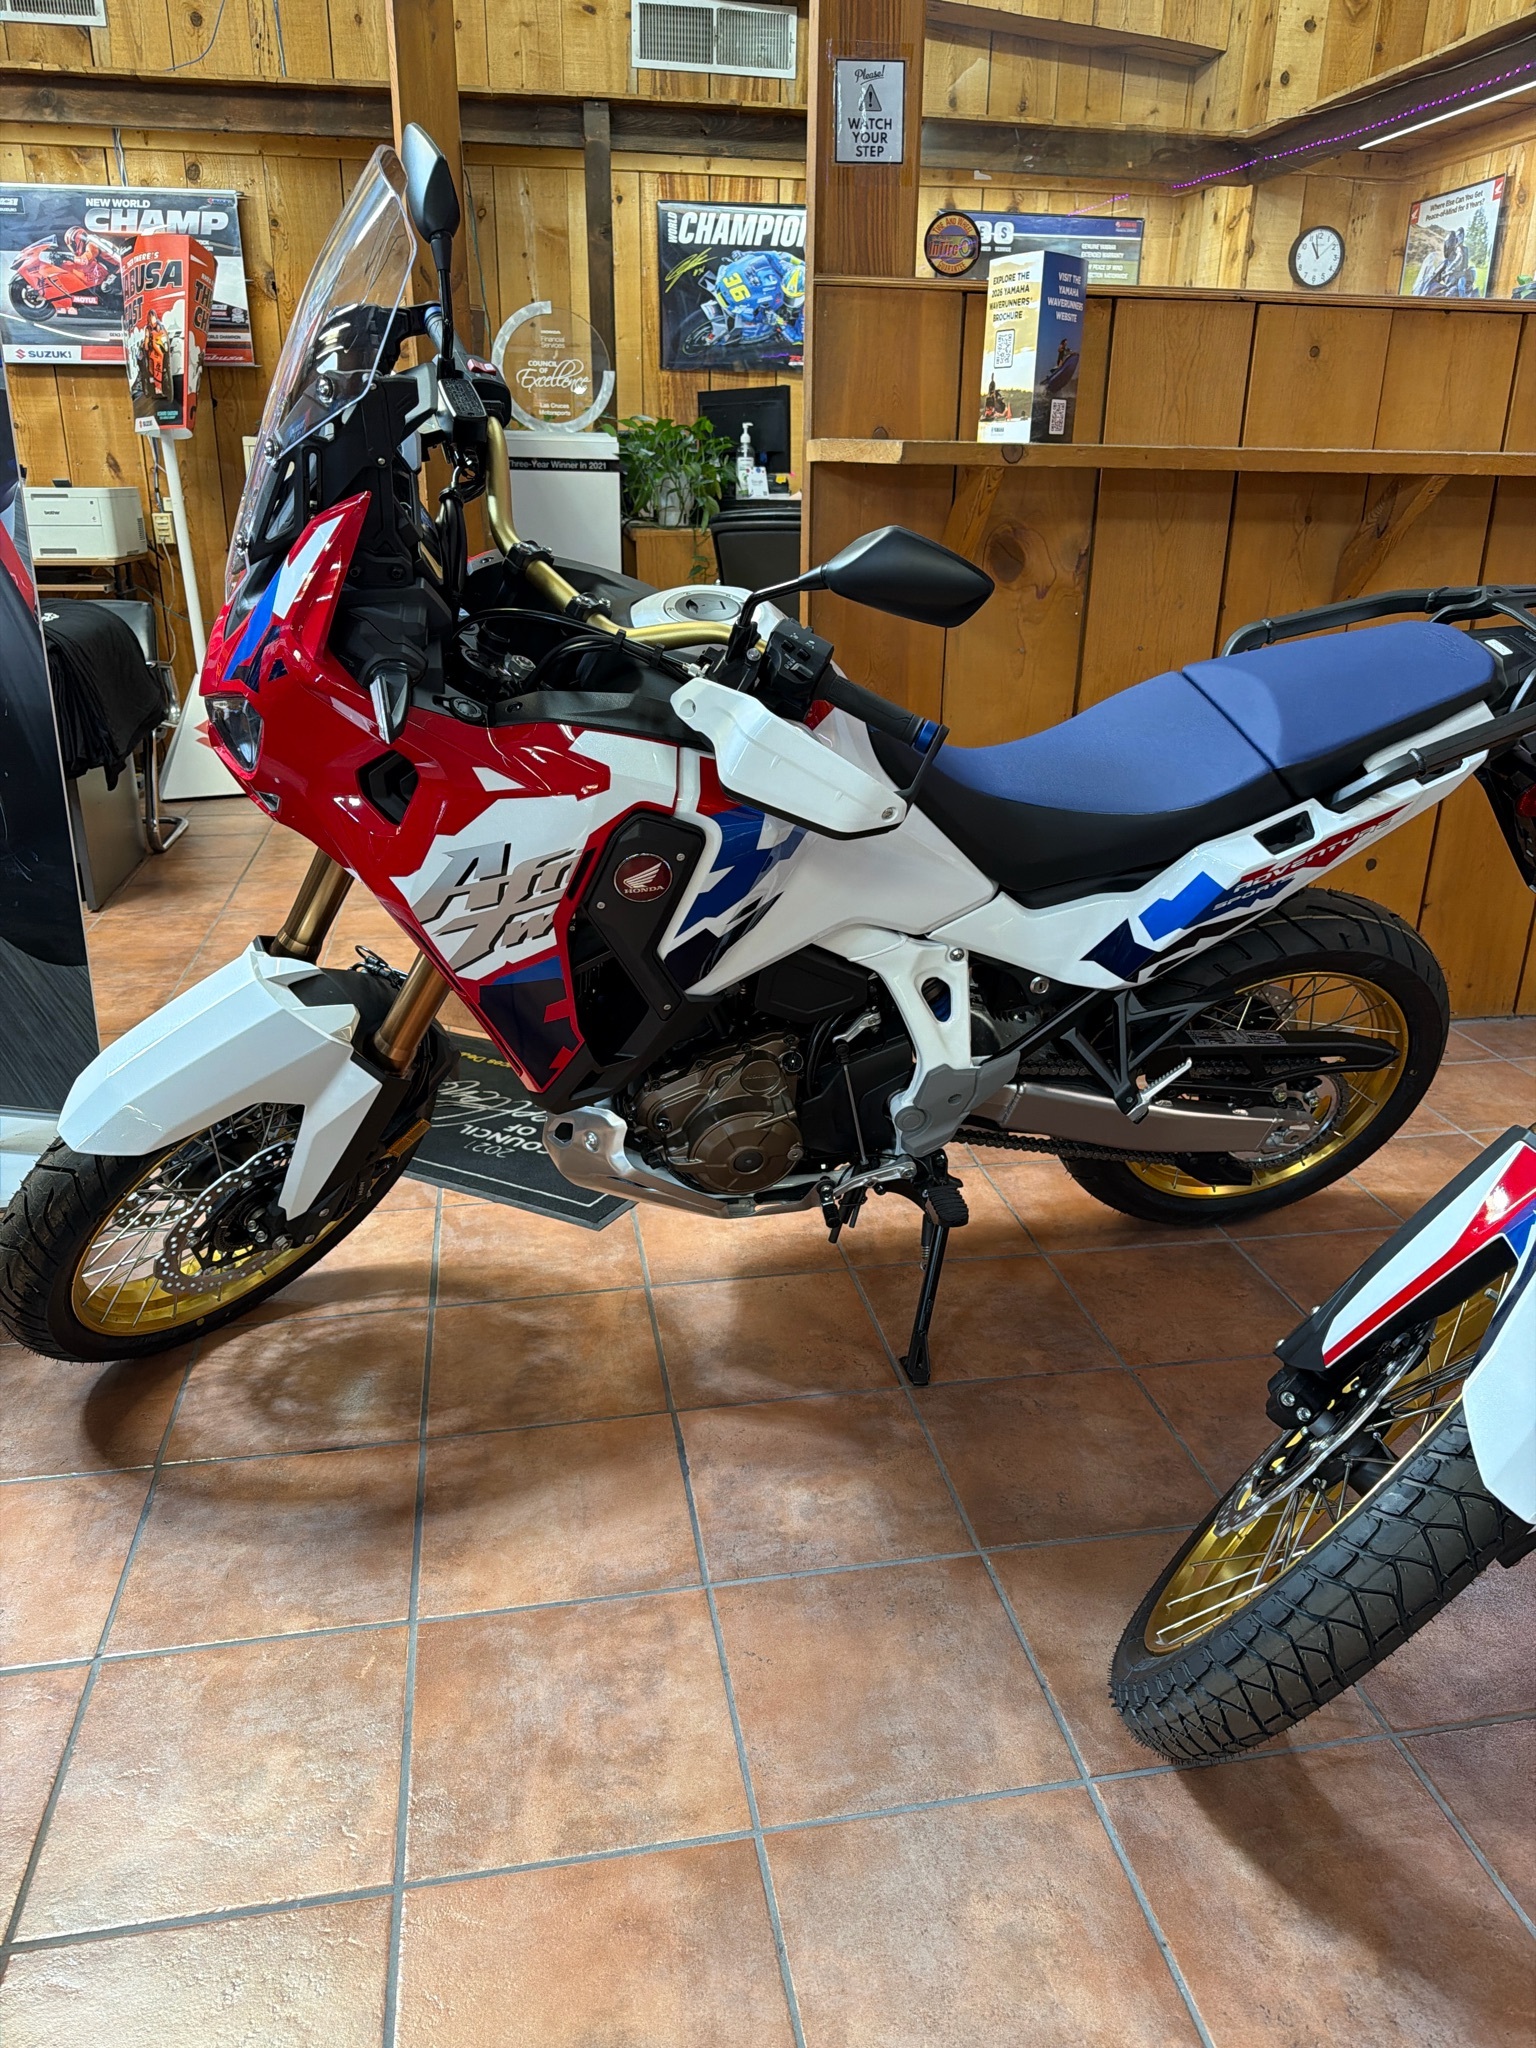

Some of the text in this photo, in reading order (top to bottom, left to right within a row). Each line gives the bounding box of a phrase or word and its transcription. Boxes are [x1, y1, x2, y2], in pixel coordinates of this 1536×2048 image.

[854, 64, 886, 84] Please!
[847, 117, 893, 131] WATCH
[852, 131, 888, 144] YOUR
[855, 145, 885, 158] STEP
[85, 198, 151, 208] NEW WORLD
[84, 207, 229, 235] CHAMP
[667, 211, 678, 243] WORLD
[933, 217, 973, 235] TIRE AND WHEEL
[993, 271, 1030, 285] EXPLORE THE
[1058, 271, 1072, 283] VISIT
[1072, 274, 1082, 285] THE
[1004, 284, 1030, 295] YAMAHA
[1058, 285, 1079, 297] YAMAHA
[73, 296, 98, 304] MOTUL
[993, 310, 1023, 322] BROCHURE
[1055, 310, 1078, 323] WEBSITE
[28, 350, 73, 359] SUZUKI
[527, 360, 558, 368] COUNCIL
[515, 358, 592, 394] Excellence
[550, 402, 570, 410] Cruces
[538, 409, 571, 417] Motorsports
[550, 460, 578, 470] Winner
[588, 462, 607, 471] 2021
[1233, 818, 1393, 893] ADVENTURE
[624, 885, 665, 894] HONDA
[1212, 873, 1296, 911] SPORTS
[503, 1123, 538, 1137] OF
[464, 1140, 516, 1159] 2021
